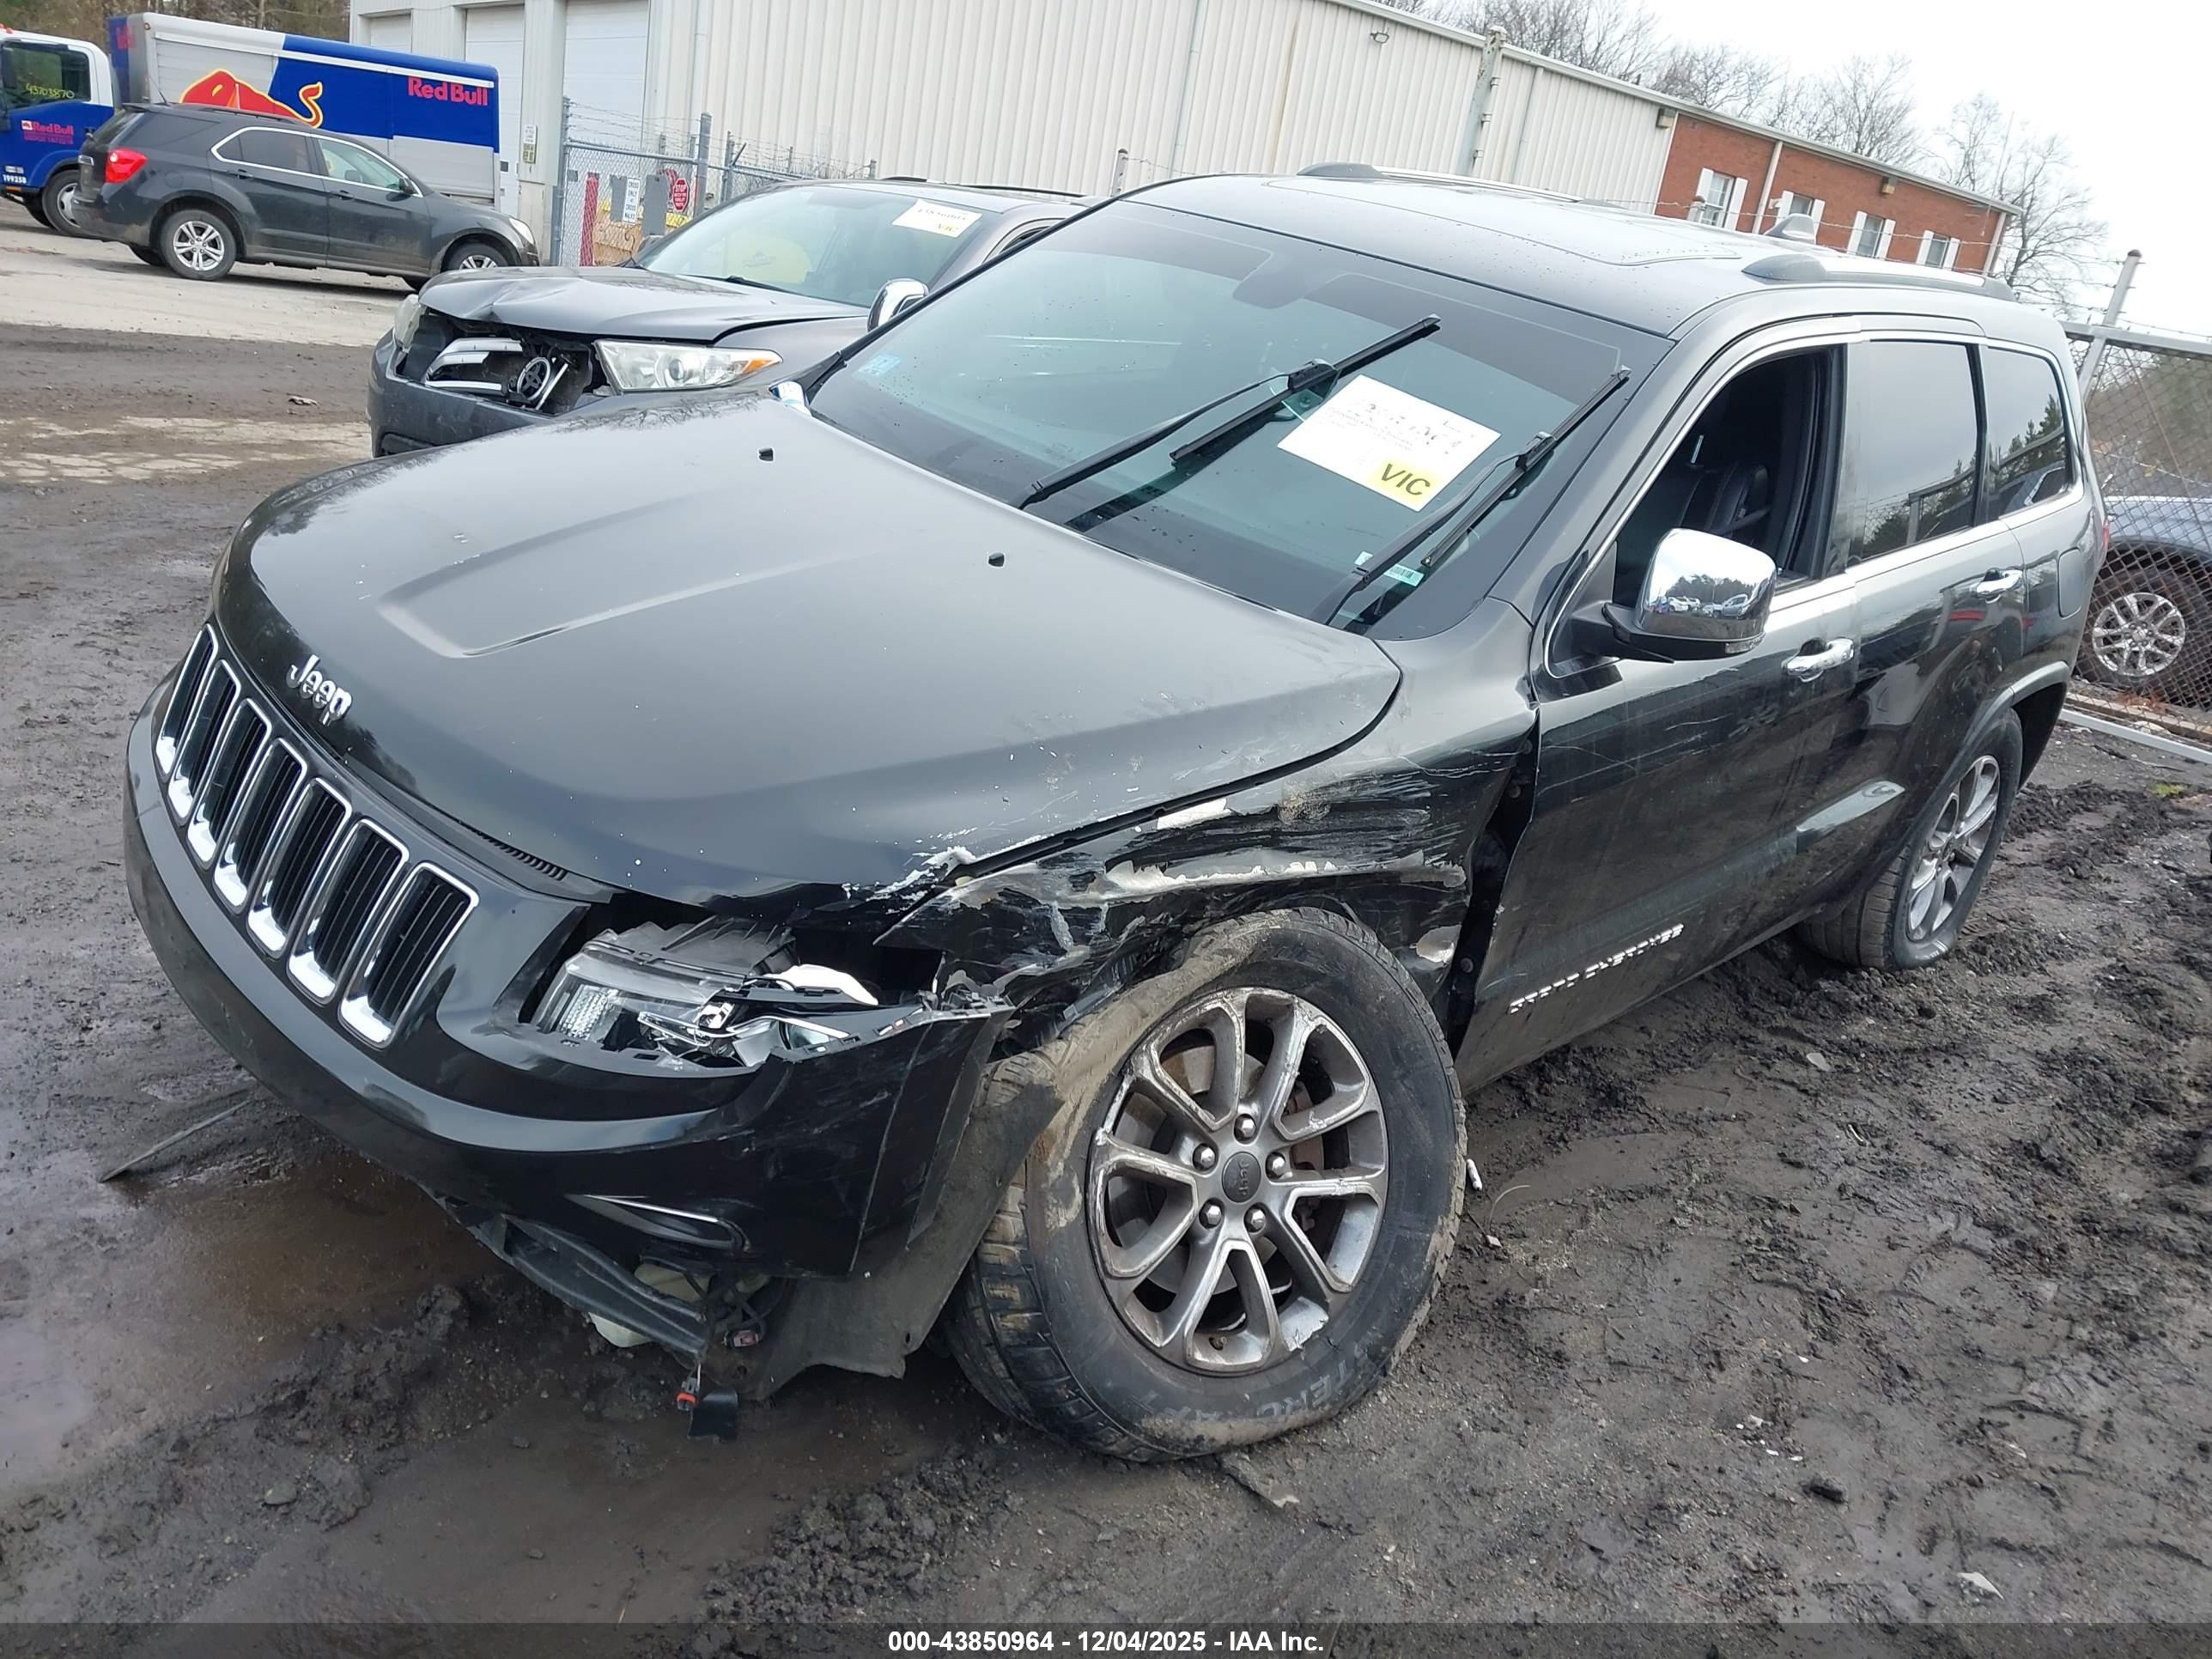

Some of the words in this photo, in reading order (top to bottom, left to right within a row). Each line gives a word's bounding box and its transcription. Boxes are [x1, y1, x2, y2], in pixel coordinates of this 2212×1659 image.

[409, 77, 447, 101] Red
[451, 83, 488, 106] Bull
[33, 122, 52, 132] Red
[54, 124, 74, 135] Bull
[1381, 463, 1431, 495] VIC
[286, 654, 352, 726] Jeep
